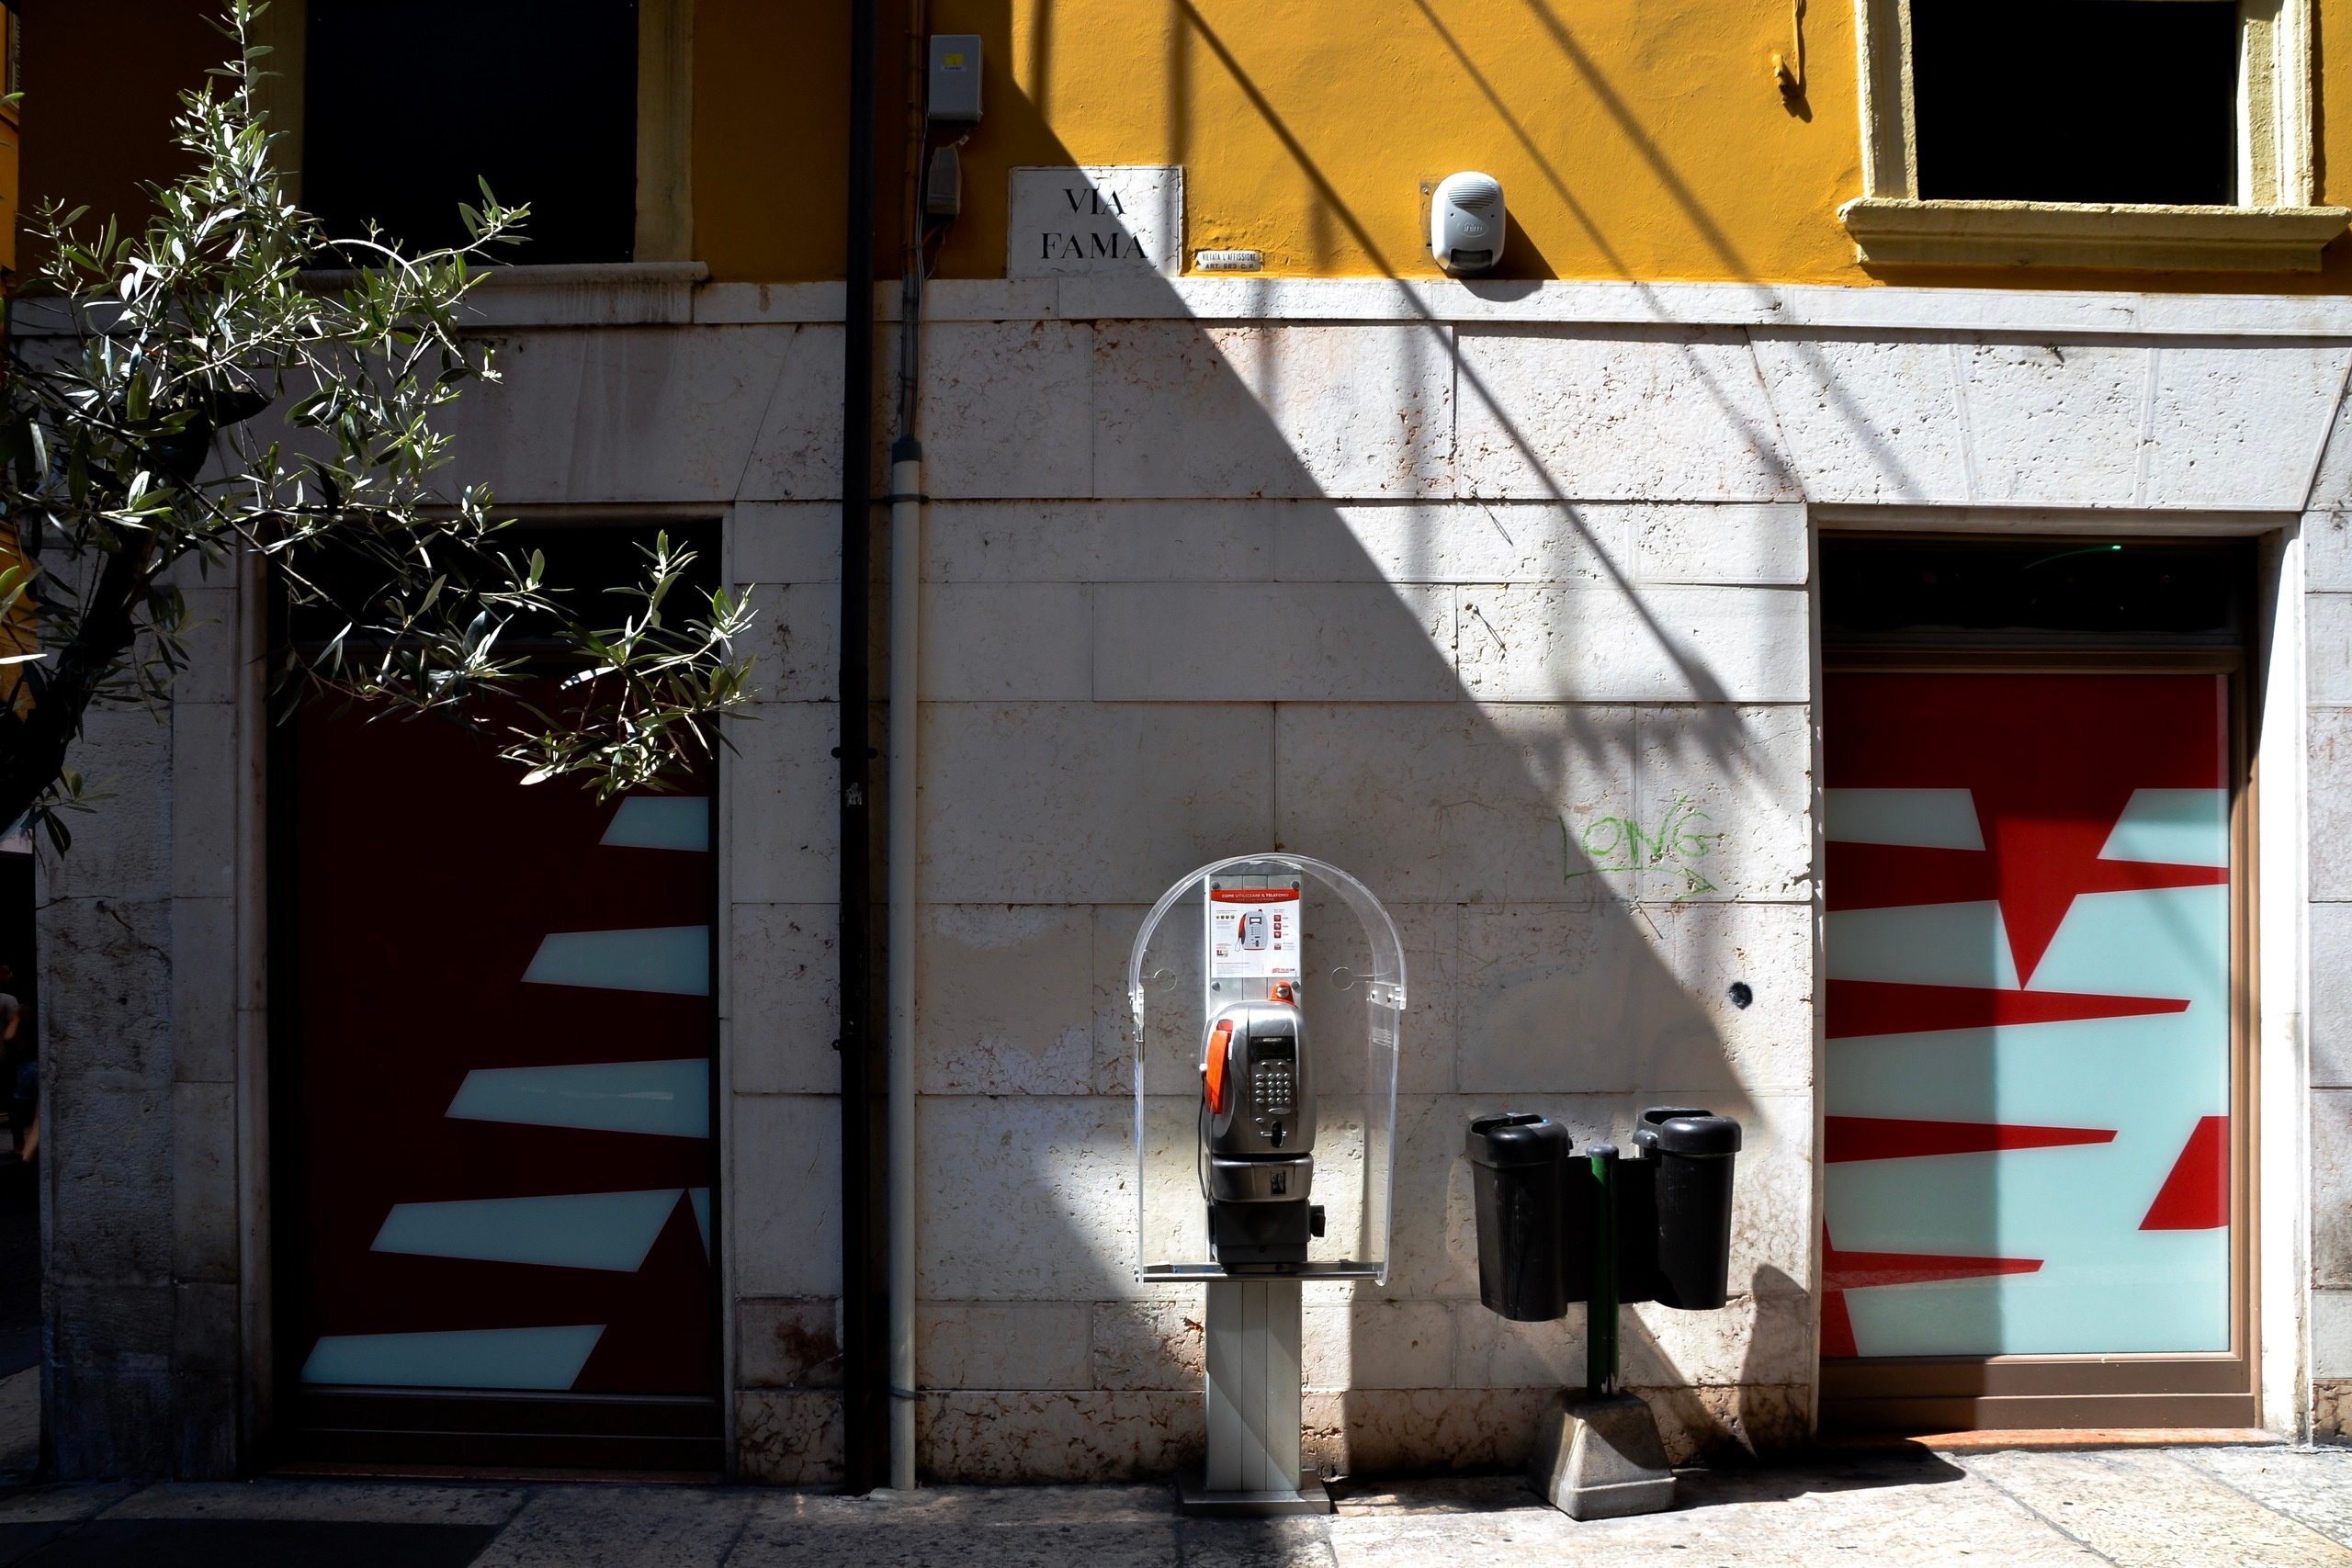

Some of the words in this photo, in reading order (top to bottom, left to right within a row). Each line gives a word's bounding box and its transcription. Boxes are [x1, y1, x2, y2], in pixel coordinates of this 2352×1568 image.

[1063, 188, 1126, 215] VIA
[1040, 232, 1148, 259] FAMA
[1203, 253, 1220, 261] VIETATA
[1223, 253, 1256, 261] L'AFFISSIONE
